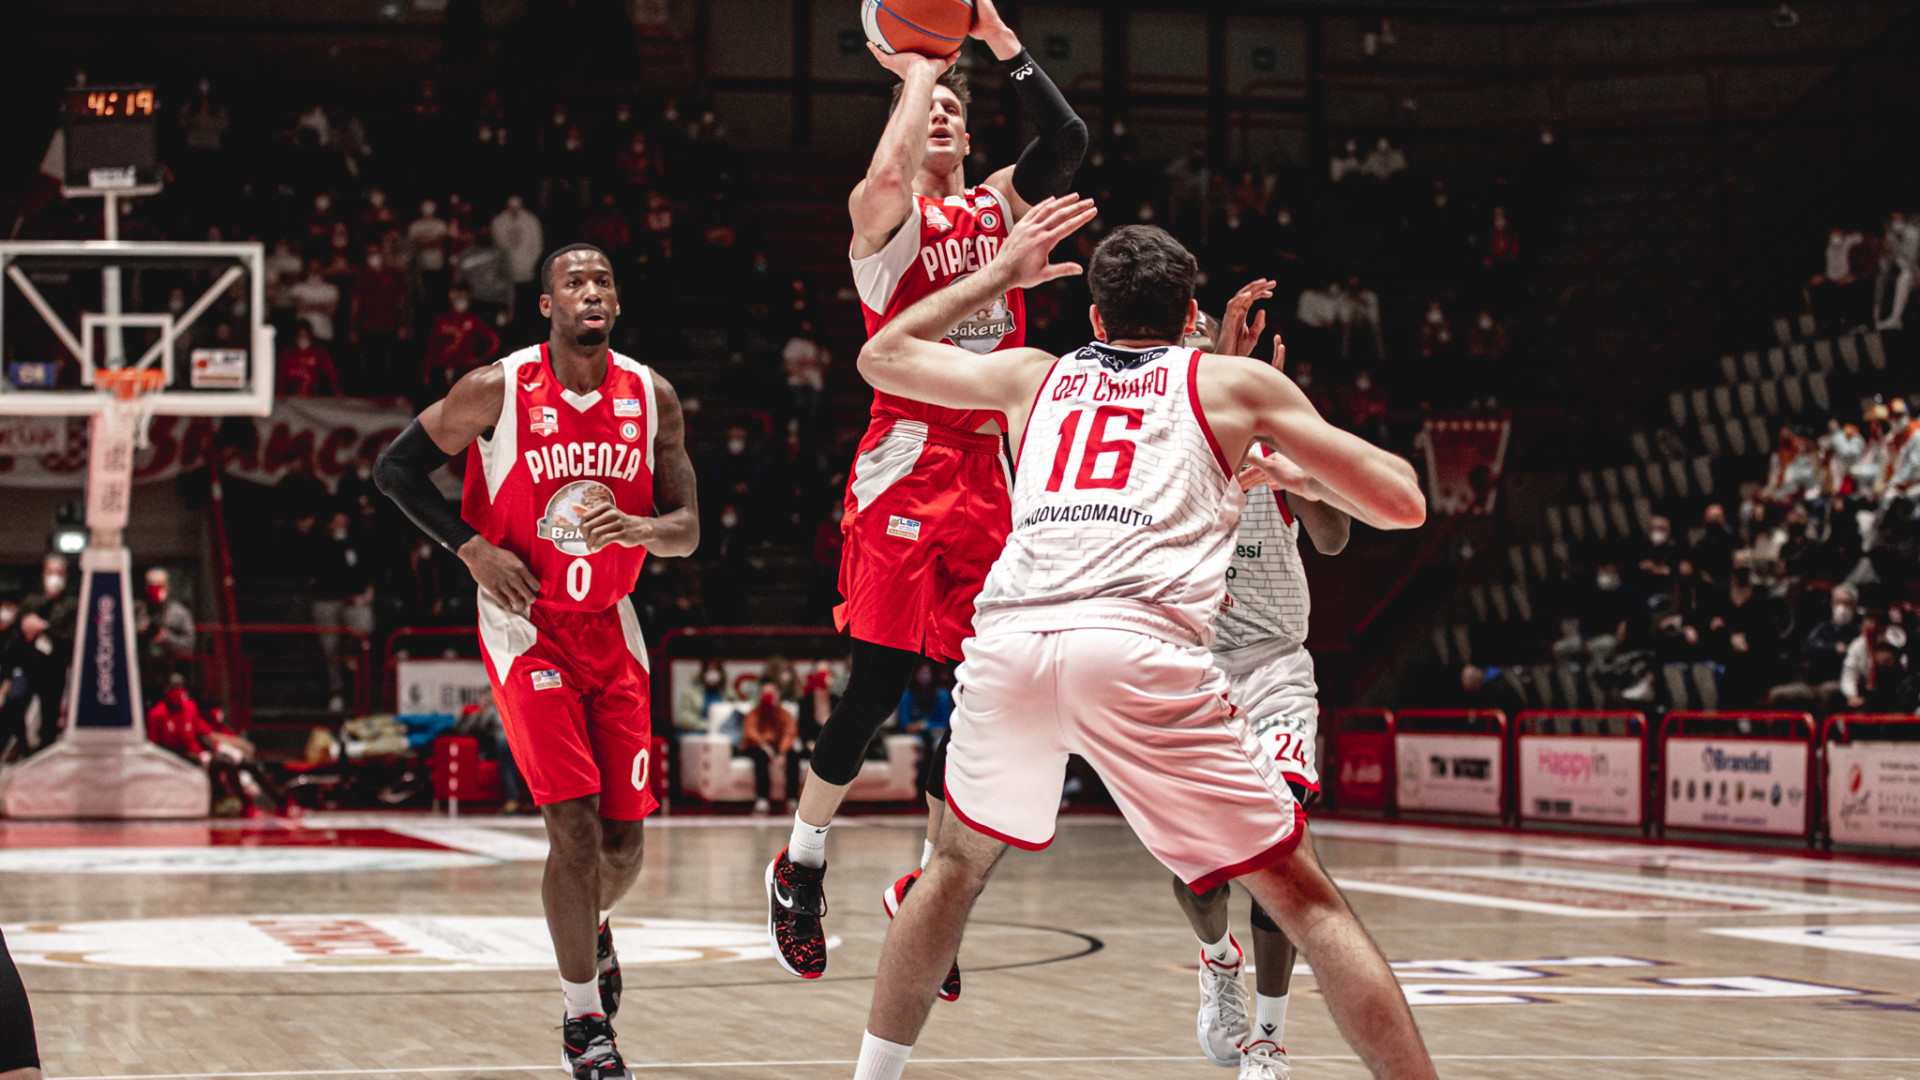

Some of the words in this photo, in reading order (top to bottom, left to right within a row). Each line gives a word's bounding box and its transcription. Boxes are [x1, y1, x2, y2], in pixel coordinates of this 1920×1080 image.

[87, 89, 154, 116] 4:19
[920, 234, 1008, 282] PIACENZ
[1092, 366, 1168, 402] CHIARO
[524, 441, 642, 484] PIACENZA
[1045, 405, 1144, 492] 16
[566, 557, 592, 602] 0
[631, 748, 649, 791] 0
[1274, 732, 1307, 769] 24
